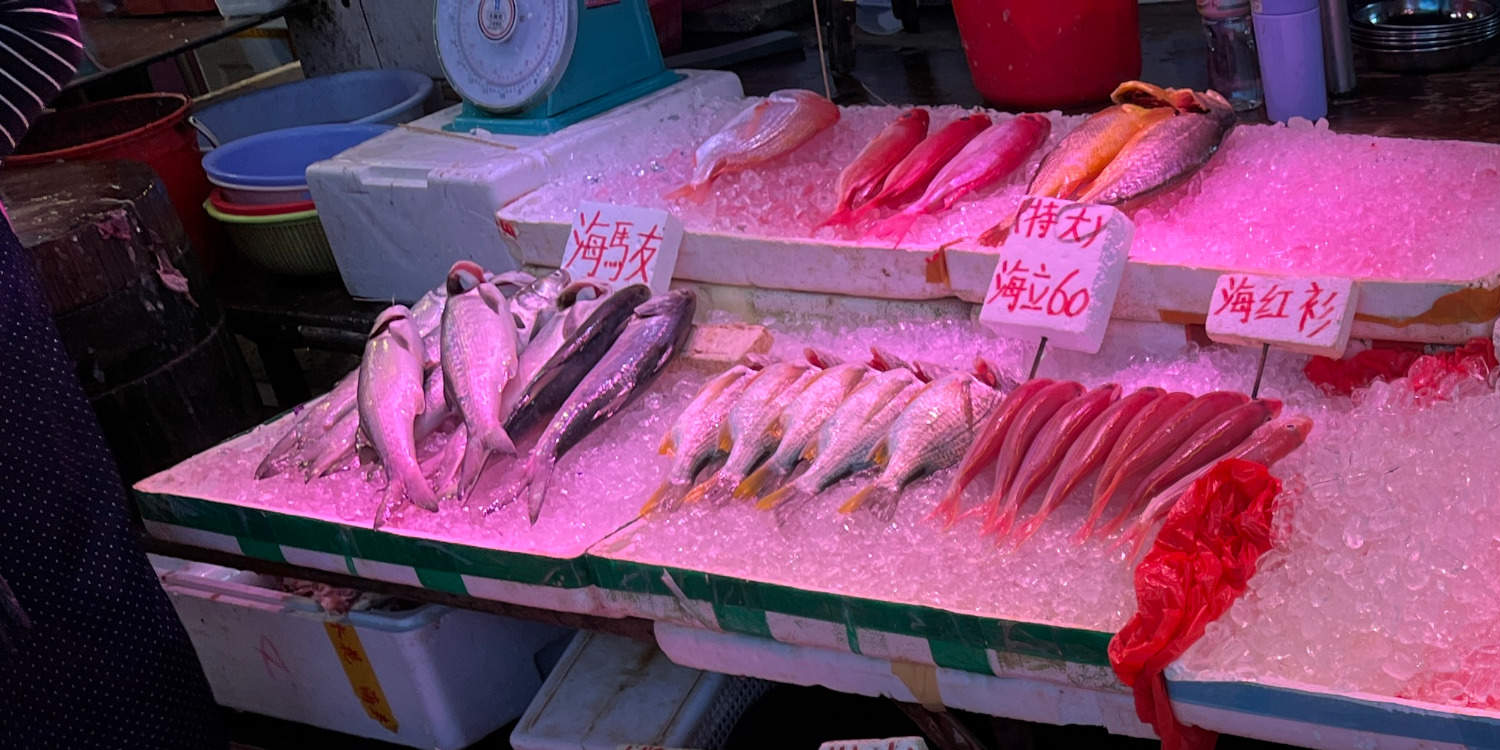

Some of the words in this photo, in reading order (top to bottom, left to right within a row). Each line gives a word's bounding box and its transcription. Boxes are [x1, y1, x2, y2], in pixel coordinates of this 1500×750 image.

[565, 210, 664, 283] 海馬友
[1213, 276, 1338, 338] 海红衫
